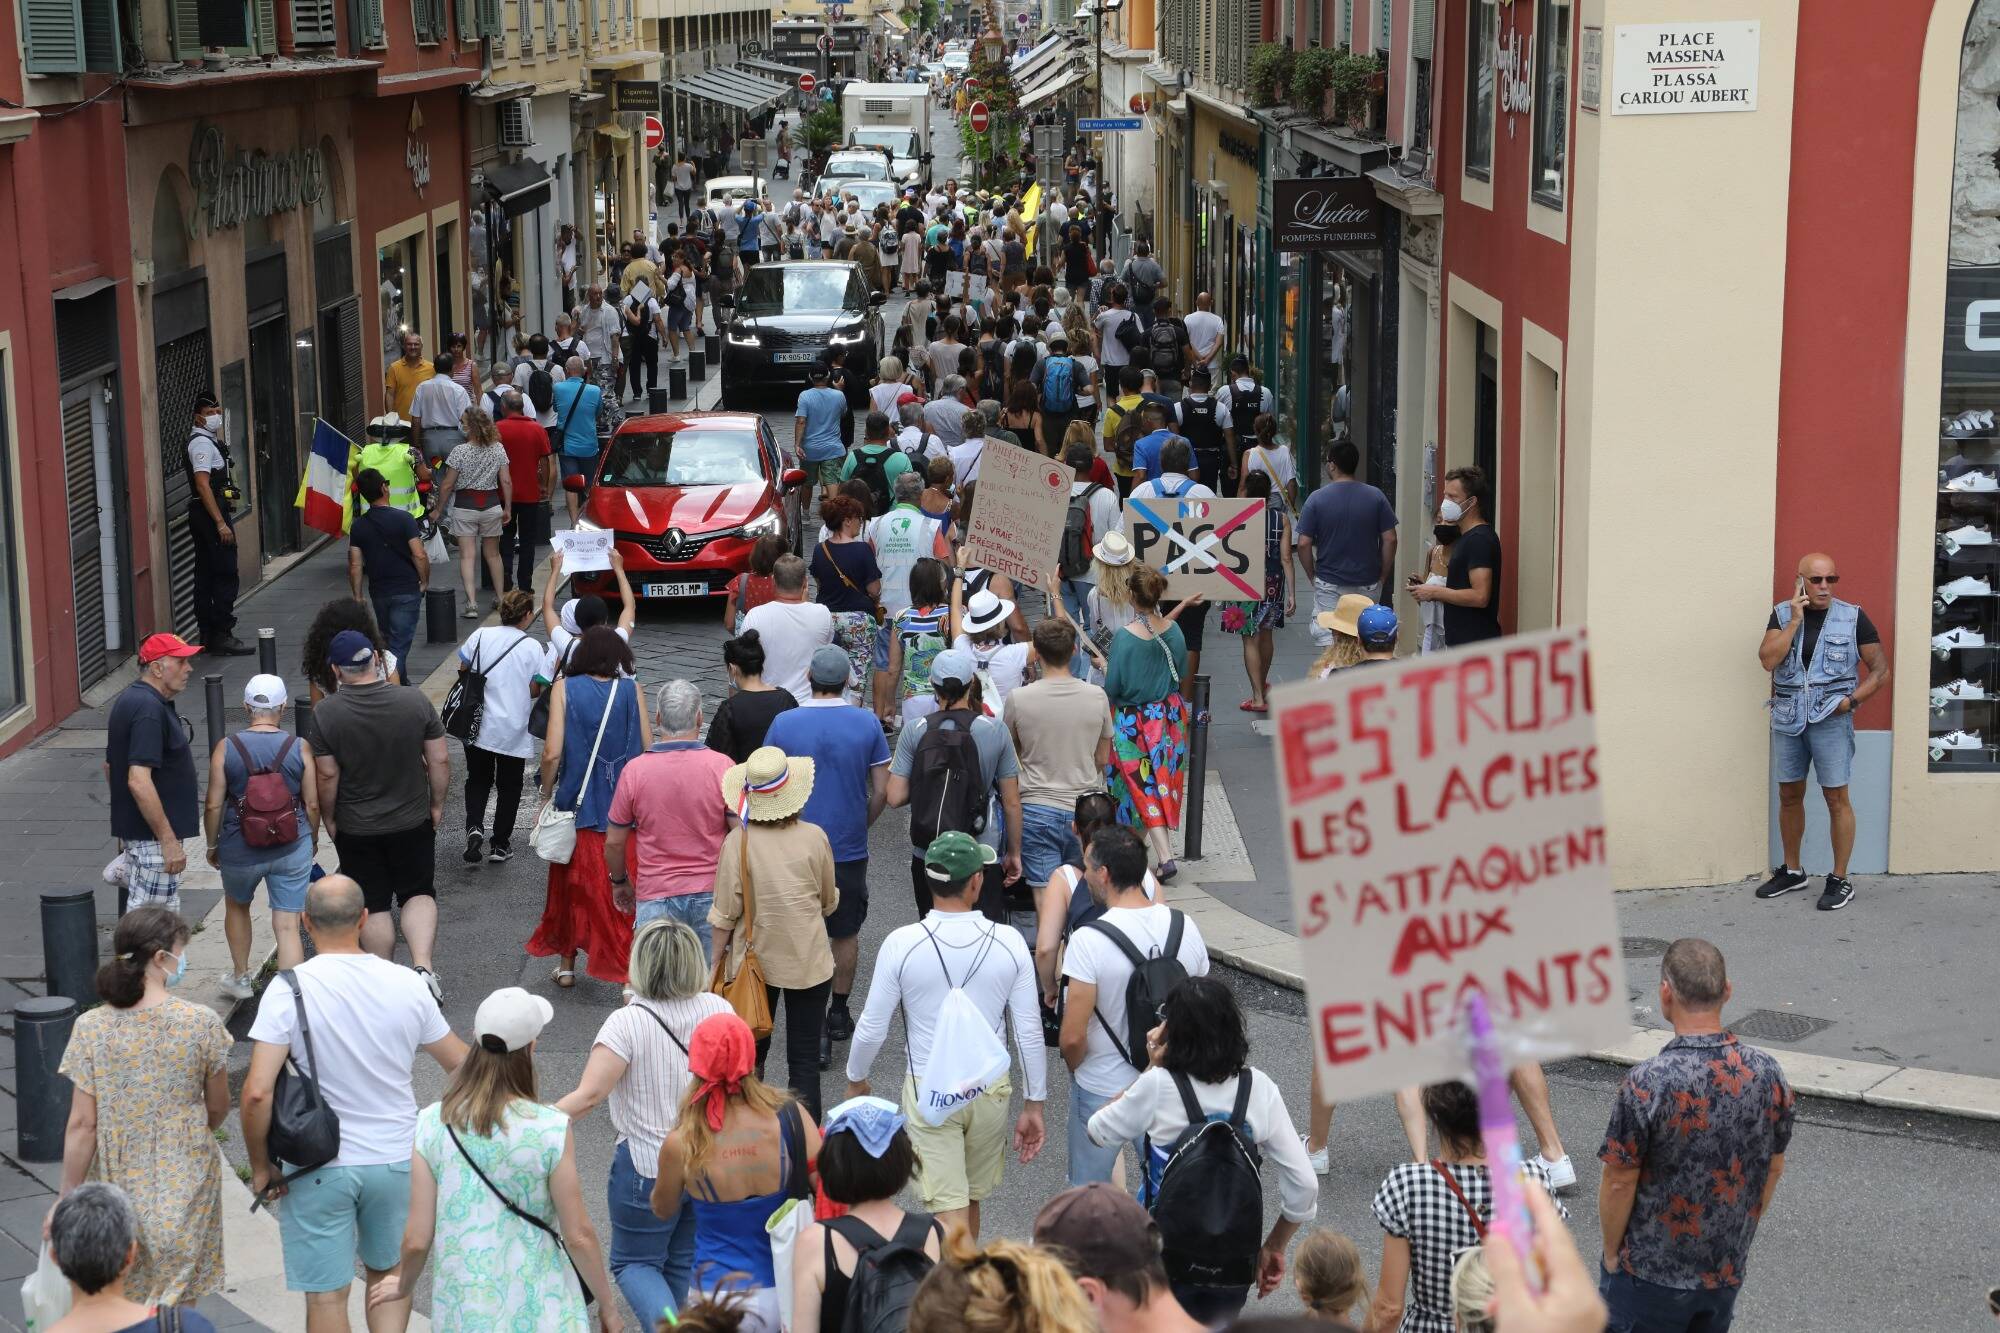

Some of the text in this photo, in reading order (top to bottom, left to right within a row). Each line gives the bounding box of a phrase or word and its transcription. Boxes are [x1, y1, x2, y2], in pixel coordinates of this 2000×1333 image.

[1646, 49, 1726, 64] MASSENA
[1659, 32, 1715, 46] PLACE
[1620, 88, 1749, 105] CARLOU AUBERT
[1653, 73, 1717, 86] PLASSA
[1287, 190, 1370, 230] Lutèce
[1281, 233, 1321, 242] POMPES
[1178, 502, 1210, 519] NO
[1133, 521, 1250, 575] PASS
[1395, 745, 1599, 834] LACHES
[1290, 797, 1372, 863] LES
[1302, 825, 1607, 937] S'ATTAQUENT
[1390, 905, 1513, 976] AUX
[1321, 945, 1613, 1066] ENFANTS
